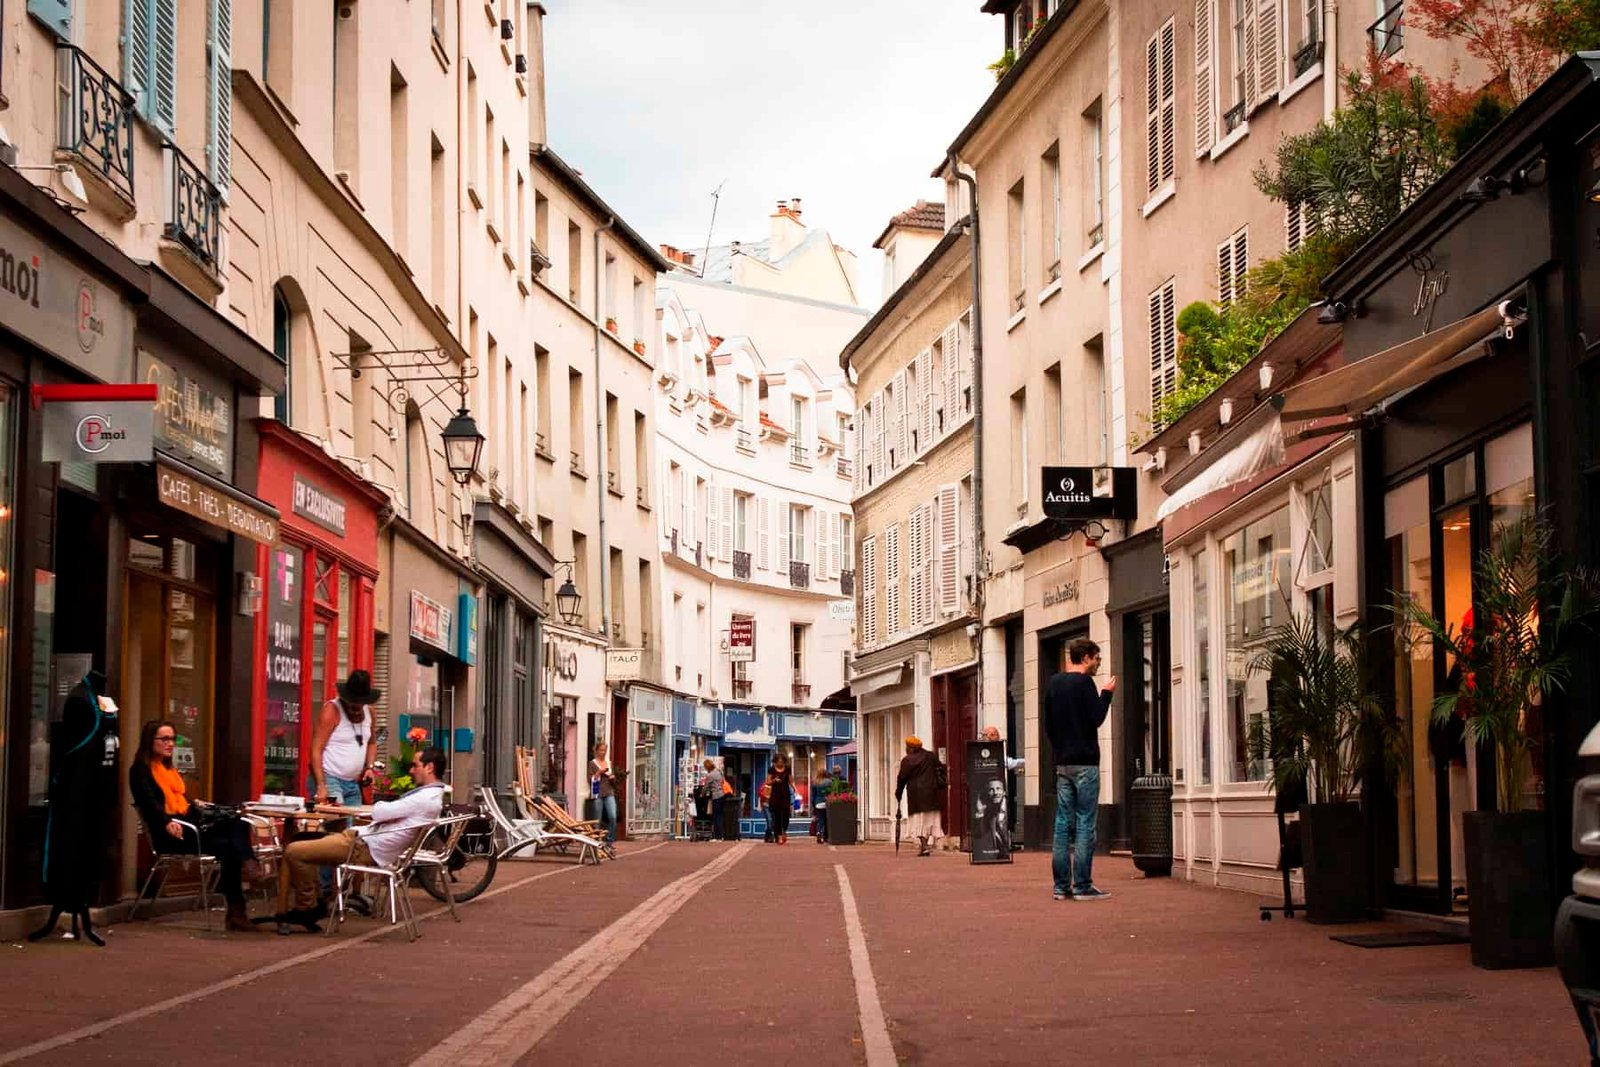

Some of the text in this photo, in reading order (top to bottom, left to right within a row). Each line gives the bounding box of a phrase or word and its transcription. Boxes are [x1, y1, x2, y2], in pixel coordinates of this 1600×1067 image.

[296, 480, 306, 509] EN
[1045, 491, 1091, 503] Acuitis
[275, 621, 292, 651] BAIL
[275, 654, 300, 685] CEDER
